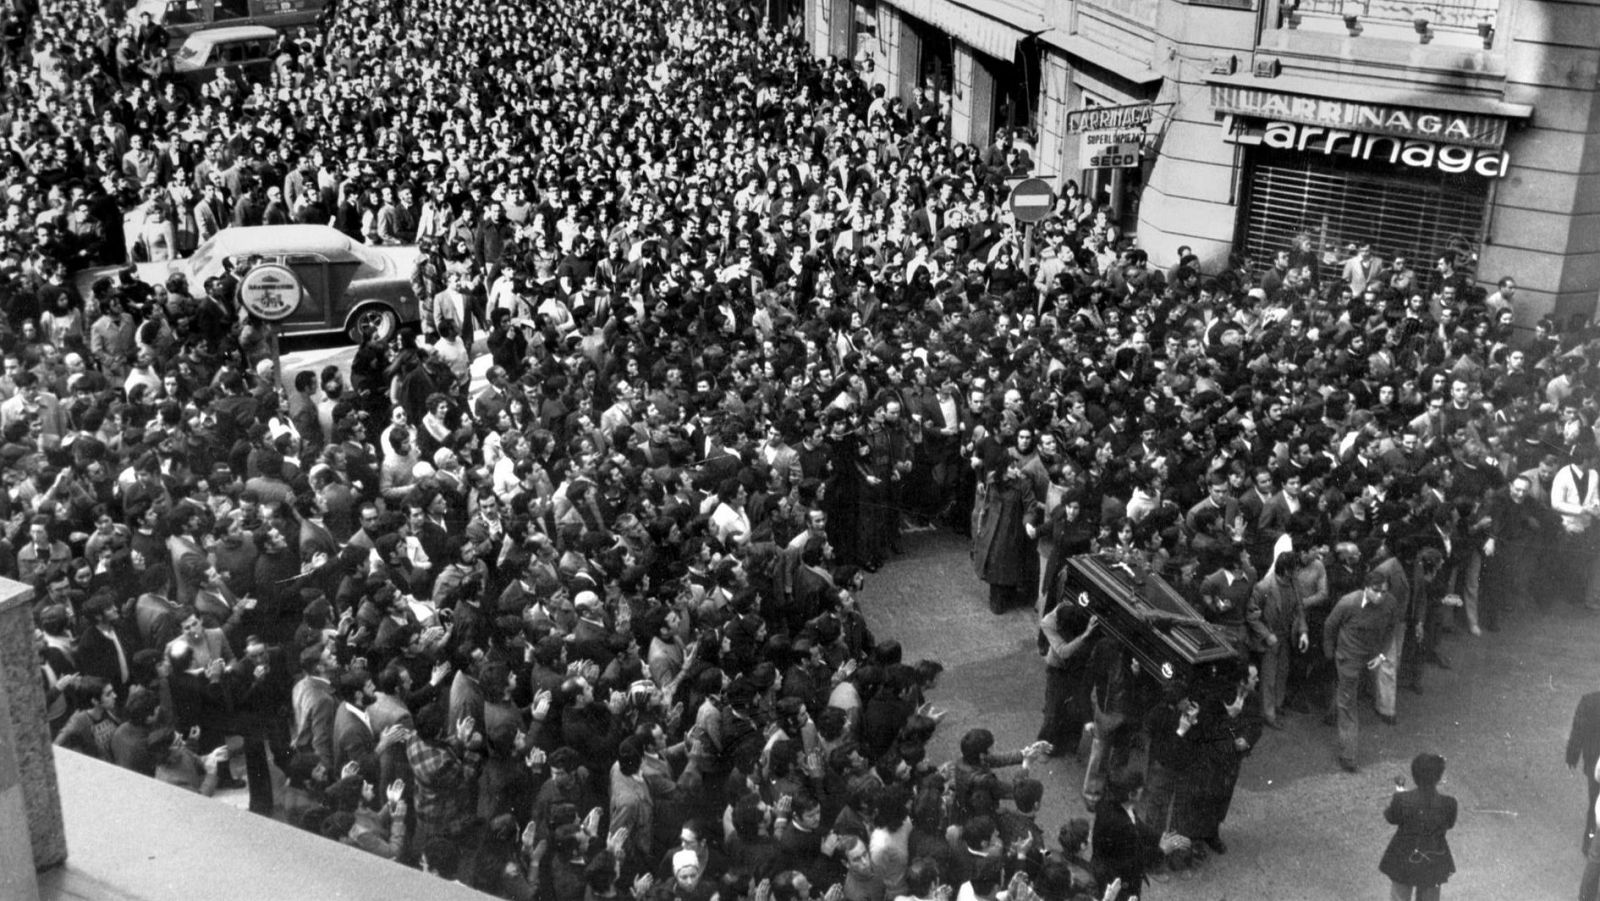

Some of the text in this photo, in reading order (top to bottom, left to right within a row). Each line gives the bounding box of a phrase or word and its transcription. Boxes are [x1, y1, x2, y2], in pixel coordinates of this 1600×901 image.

[1070, 107, 1152, 131] LARRINAGA
[1239, 90, 1471, 138] LARRINAGA
[1090, 155, 1134, 167] SECO
[1223, 115, 1509, 177] Larrinaga
